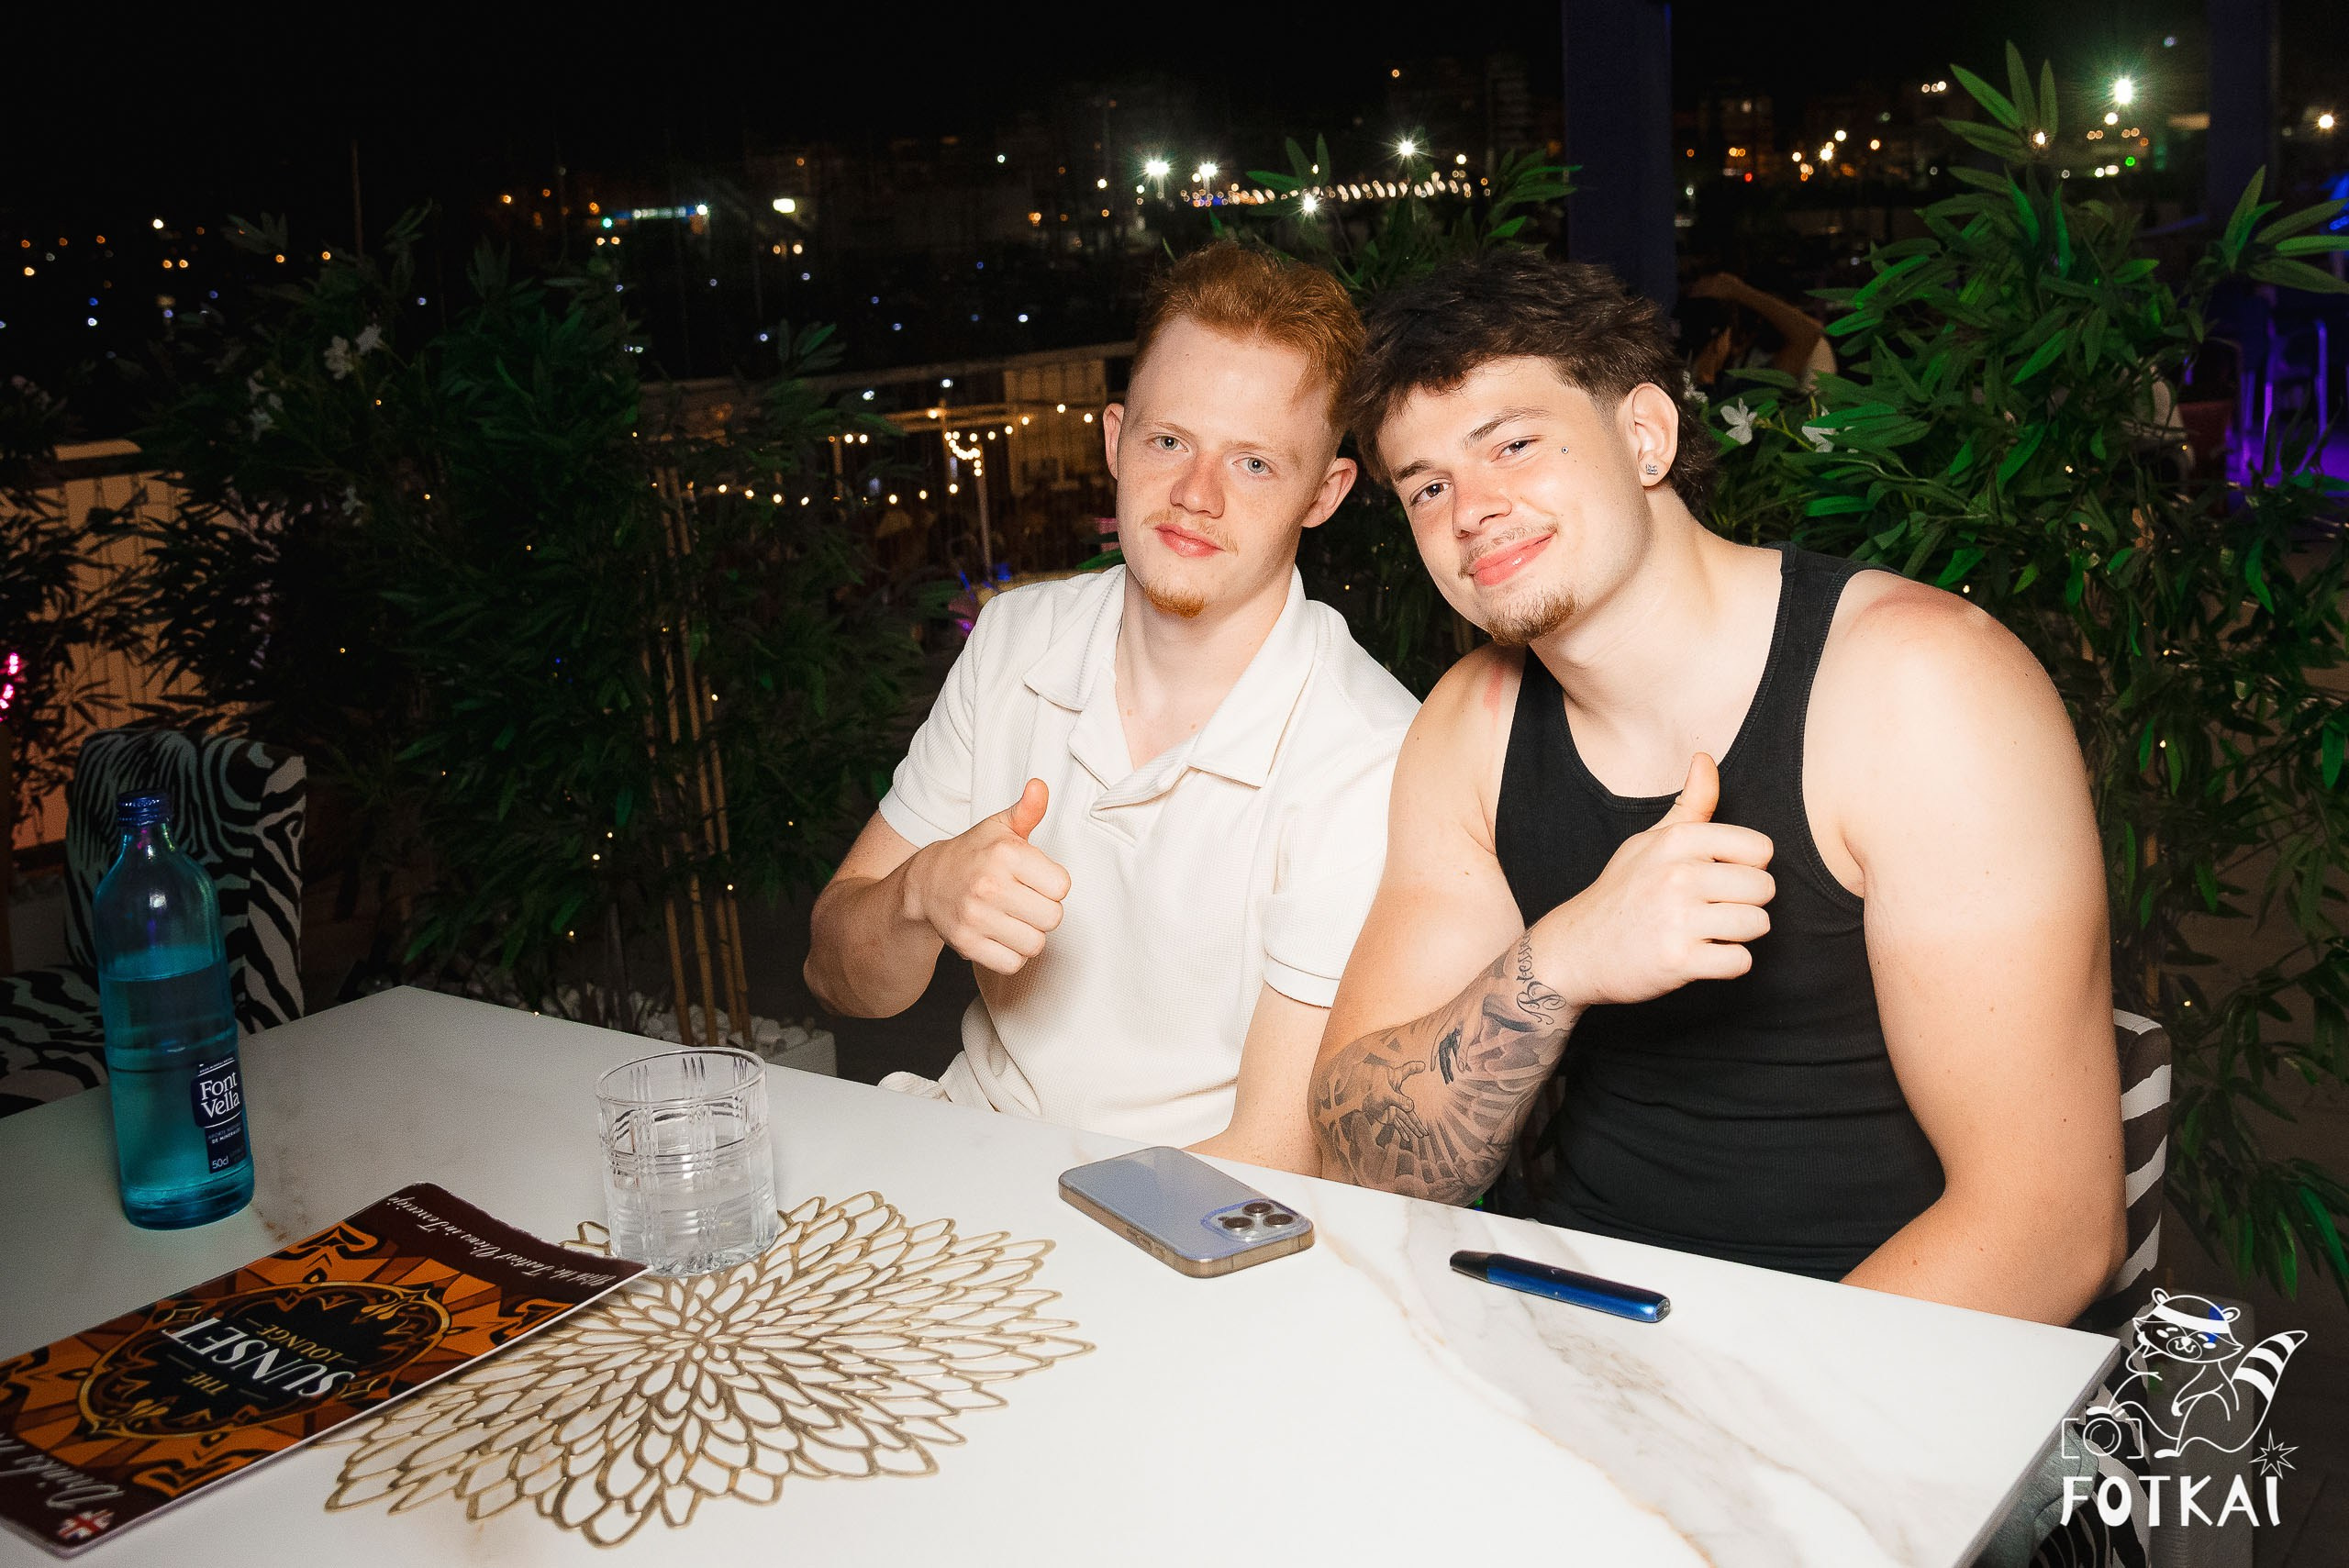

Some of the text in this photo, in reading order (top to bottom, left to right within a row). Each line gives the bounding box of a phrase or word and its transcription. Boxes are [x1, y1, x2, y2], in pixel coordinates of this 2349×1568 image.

[199, 1072, 238, 1101] Font
[200, 1090, 240, 1118] Vella
[460, 1233, 501, 1258] Views
[494, 1252, 554, 1276] Tastiest
[161, 1317, 356, 1397] SUNSET
[256, 1324, 345, 1363] LOUNGE
[184, 1372, 228, 1396] THE
